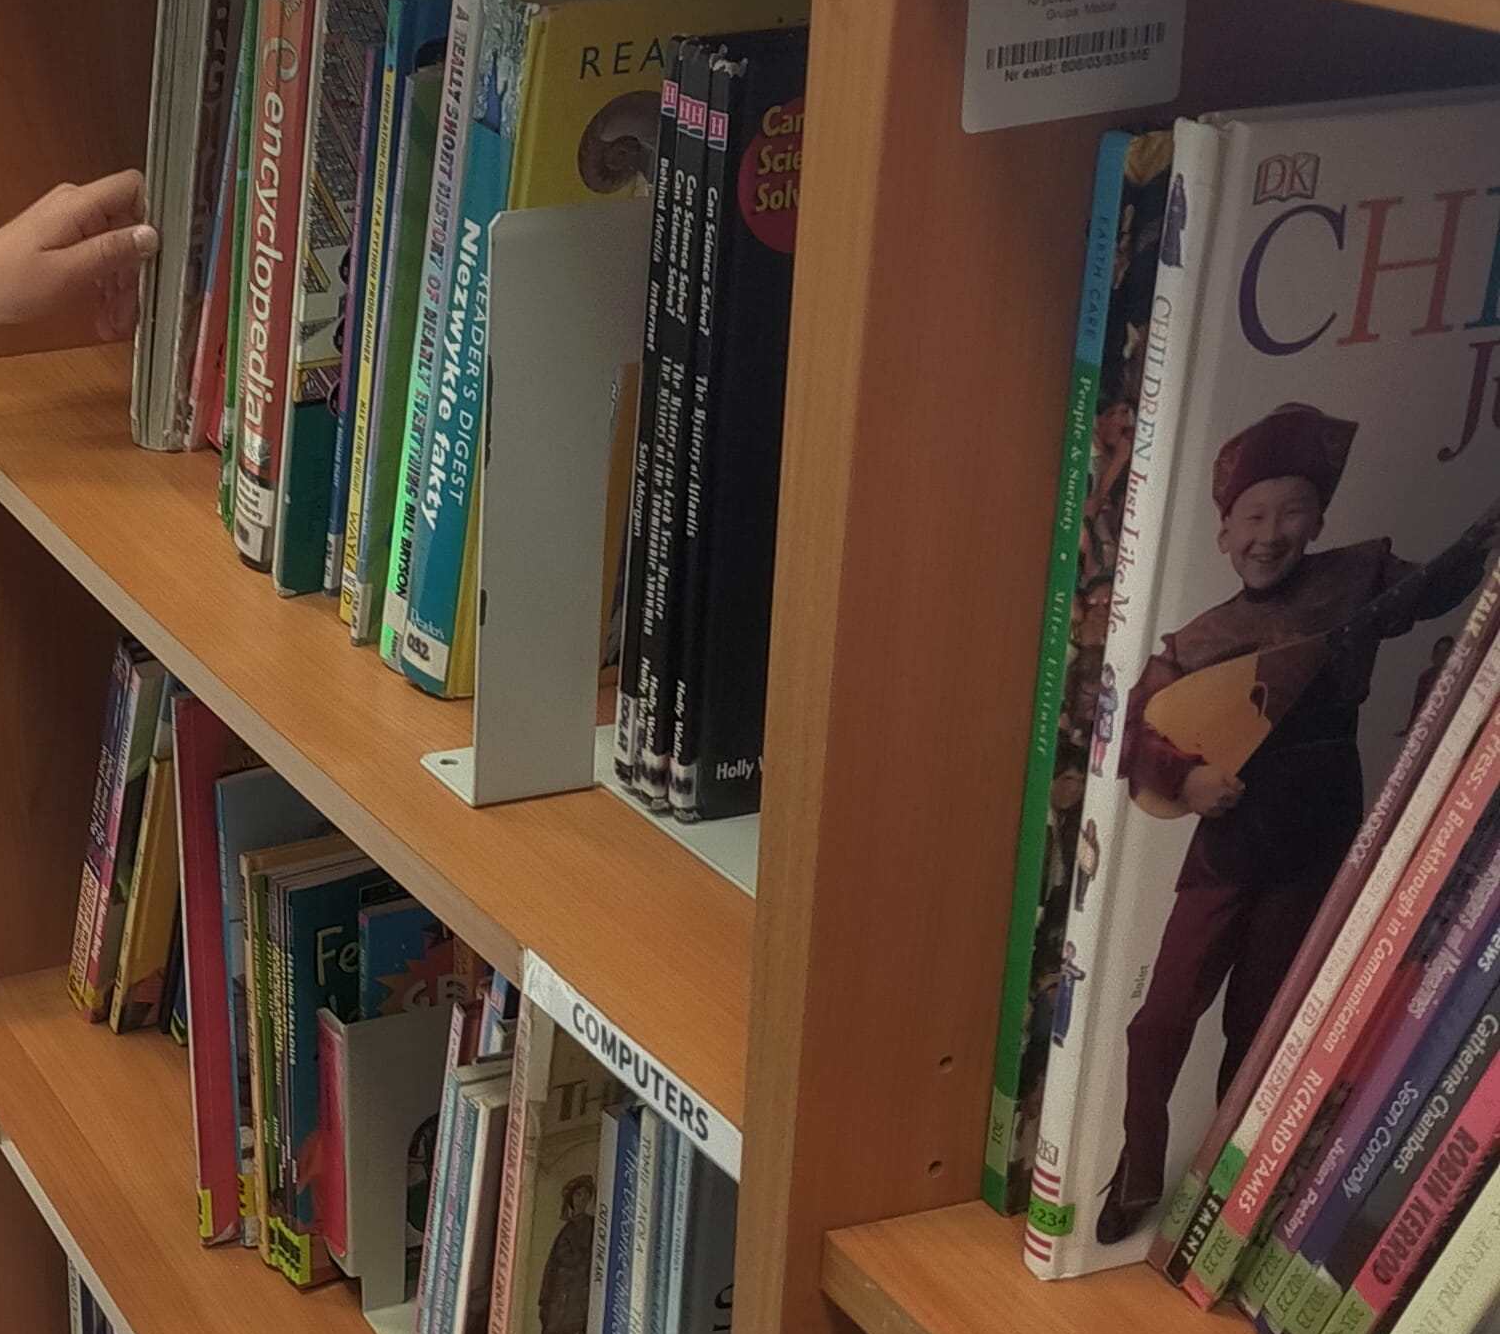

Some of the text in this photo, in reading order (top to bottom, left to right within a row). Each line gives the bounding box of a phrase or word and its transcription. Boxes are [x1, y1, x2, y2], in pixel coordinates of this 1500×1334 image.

[1260, 158, 1313, 196] DK
[243, 91, 285, 428] encyclopedia
[395, 6, 469, 600] A REALLY SHORT HISTORY OF NEARLY EVERYTHING BILL BRYSON
[665, 168, 685, 318] Can Science Solve?
[676, 174, 698, 326] Can Science Solve?
[697, 186, 719, 338] Can Science Solve?
[1083, 215, 1110, 341] EARTH CARE
[420, 216, 482, 532] Niezwykłe fakty
[448, 271, 489, 507] READER'S DIGEST
[632, 157, 670, 538] Behind Media Internet Sally Morgan
[694, 374, 709, 404] The
[690, 406, 708, 466] Mystery
[1059, 375, 1092, 532] People & Society
[1106, 295, 1174, 636] CHILDREN Just Like Me
[685, 479, 702, 539] Atlantis
[637, 656, 651, 693] Holly
[647, 673, 660, 709] Holly
[675, 678, 688, 719] Holly
[715, 758, 756, 781] Holly
[1237, 797, 1475, 1217] A Breakthrough in Communication RICHARD TAMES
[573, 1003, 709, 1141] COMPUTERS
[1393, 1013, 1499, 1174] Catherine Chambers
[619, 1147, 638, 1183] The
[1283, 1136, 1347, 1240] Julian Petley
[1341, 1080, 1420, 1201] Sean Connolly
[595, 1243, 606, 1265] THE
[598, 1203, 609, 1227] OUT
[613, 1184, 638, 1267] Usborne
[1371, 1125, 1480, 1286] ROBIN KERROD
